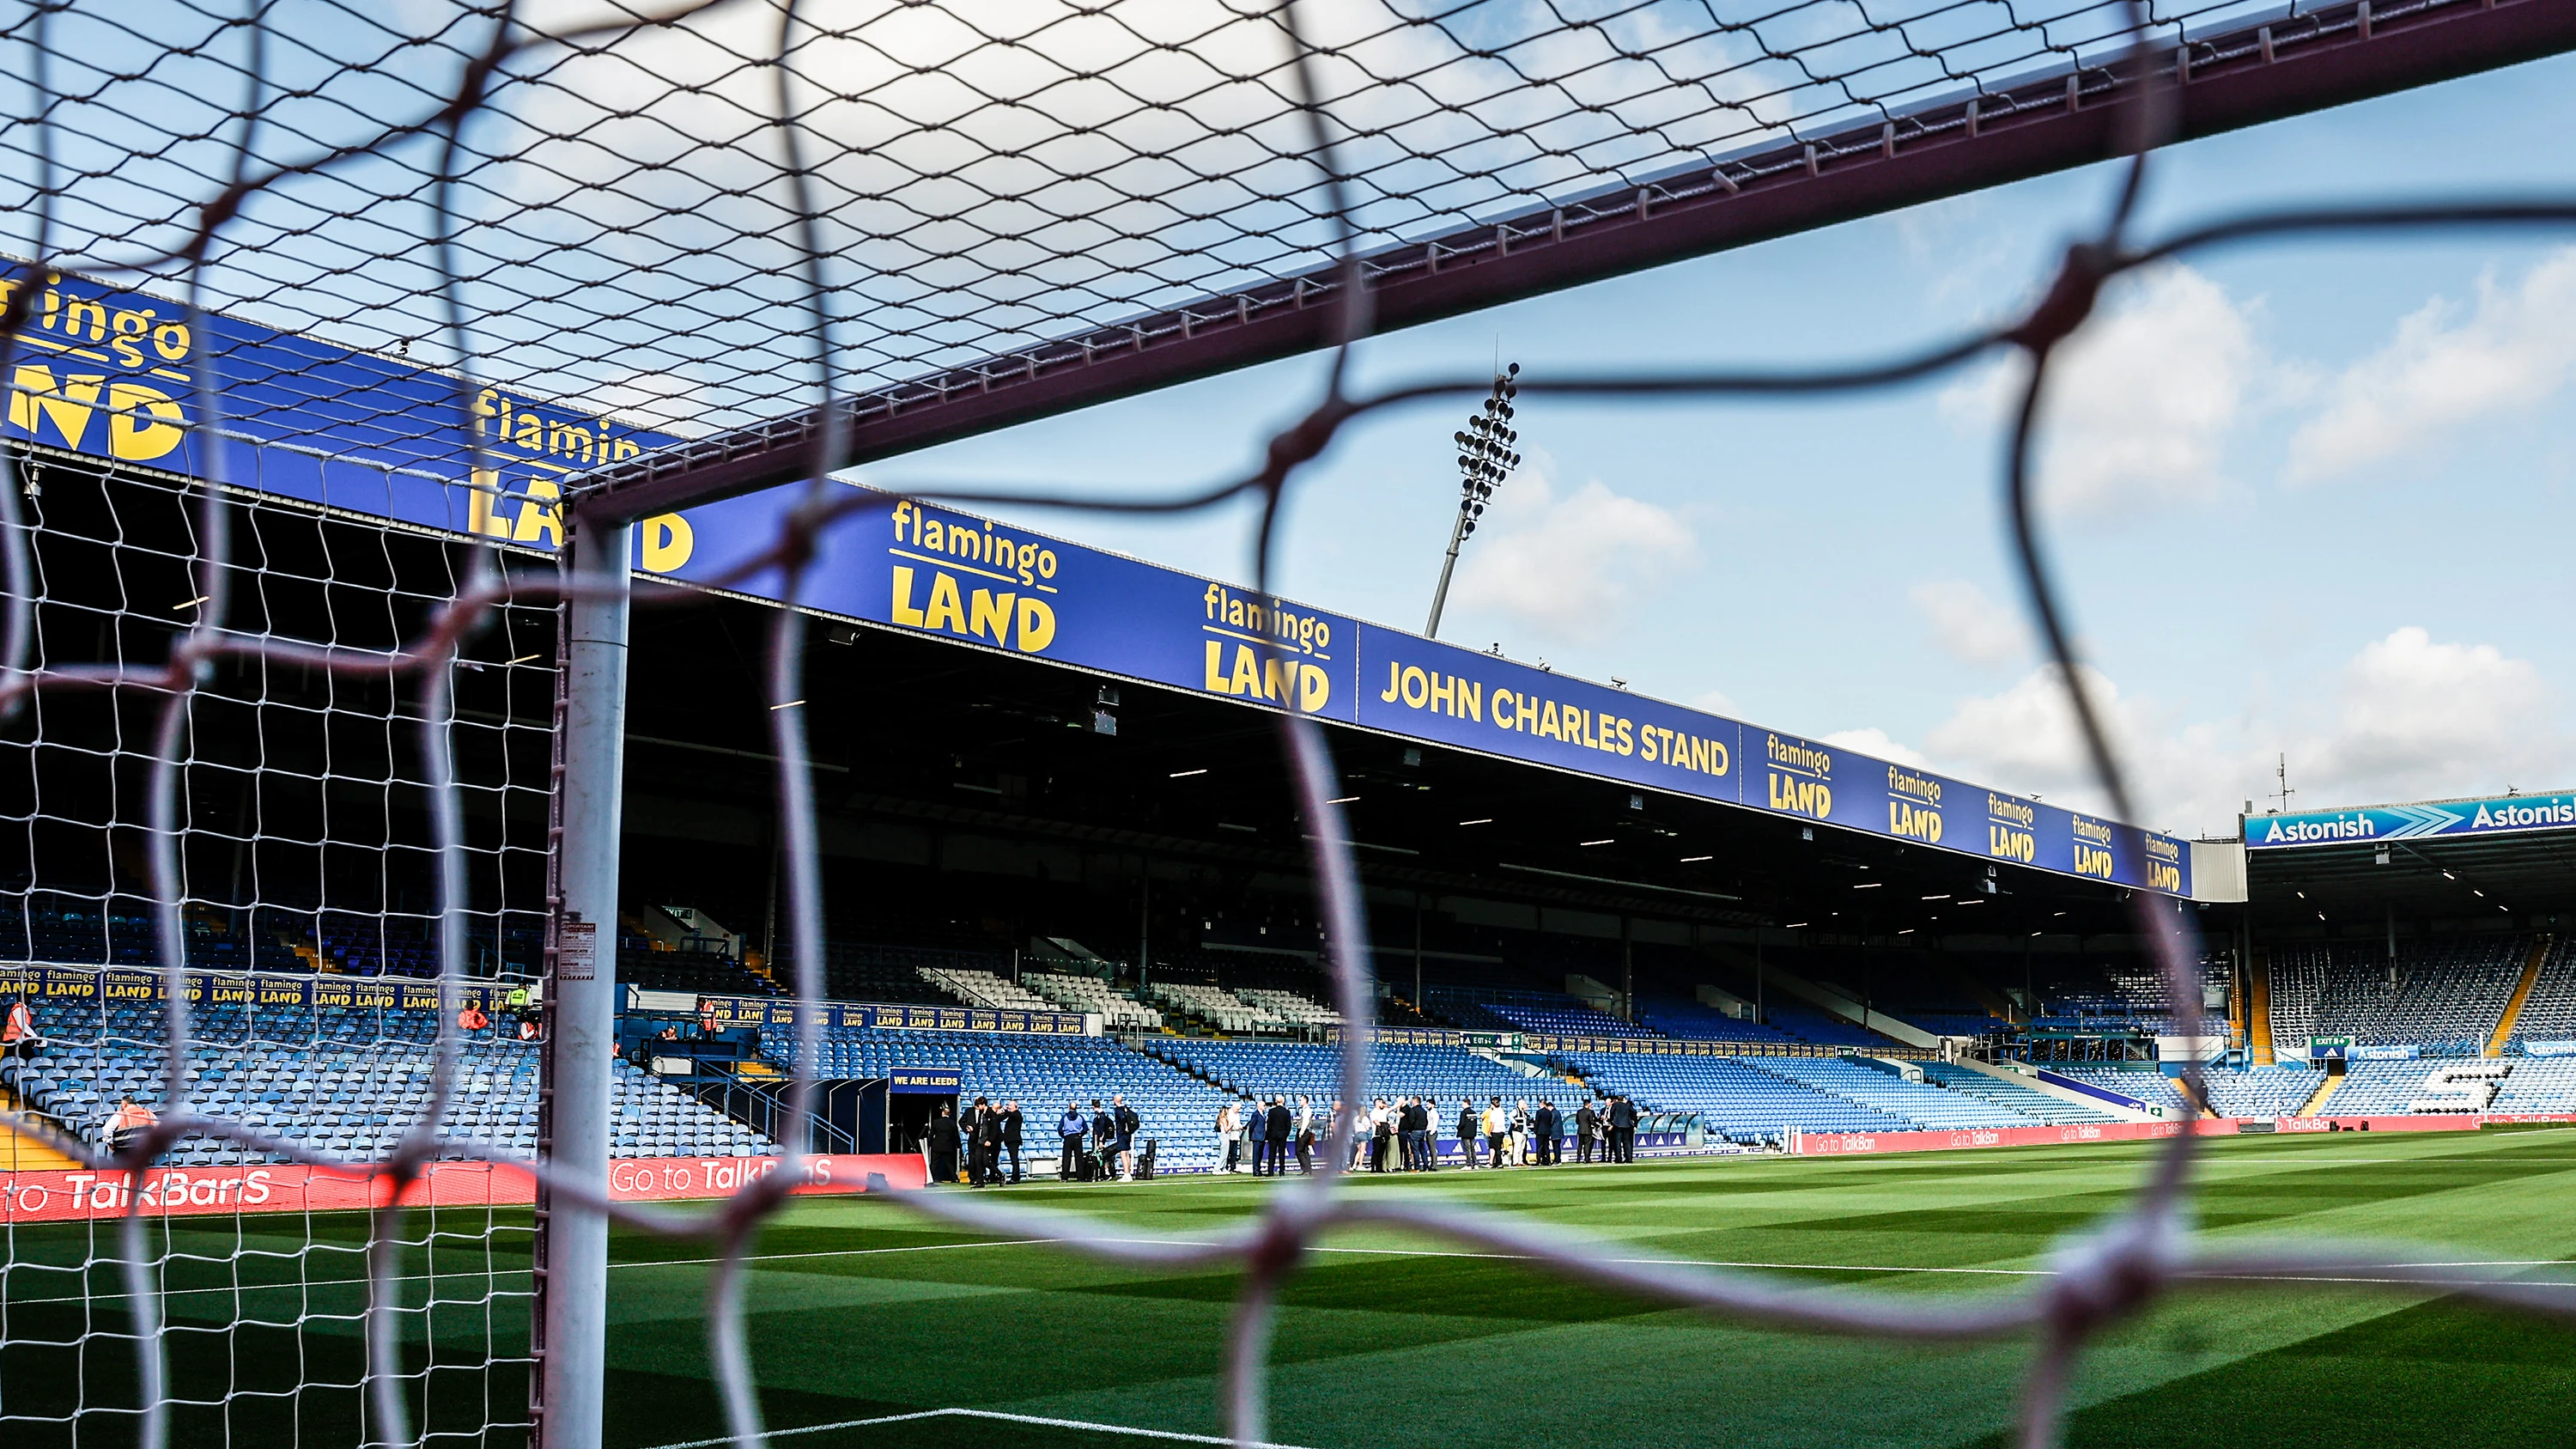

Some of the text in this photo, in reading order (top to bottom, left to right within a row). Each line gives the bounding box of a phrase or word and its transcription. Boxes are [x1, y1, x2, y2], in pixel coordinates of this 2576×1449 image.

[468, 466, 694, 574] LAD
[891, 501, 1058, 586] flamingo
[891, 564, 1056, 652] LAND
[1204, 583, 1330, 654] flamingo
[1206, 640, 1330, 713] LAND
[1381, 661, 1728, 776] JOHN CHARLES STAND
[1767, 734, 1831, 777] flamingo
[1887, 765, 1941, 807] flamingo
[1768, 772, 1832, 819] LAND
[1988, 792, 2033, 830] flamingo
[2471, 797, 2576, 829] Astonis
[1889, 801, 1942, 843] LAND
[2264, 813, 2374, 843] Astonish
[2072, 814, 2111, 845] flamingo
[1989, 825, 2035, 863] LAND
[2145, 832, 2178, 862] flamingo
[2074, 844, 2113, 879] LAND
[2147, 861, 2180, 892] LAND
[46, 970, 95, 983] flamingo
[106, 972, 152, 984] flamingo
[213, 977, 256, 988] flamino
[46, 983, 94, 996] LAND
[106, 985, 152, 998] LAND
[260, 979, 302, 991] flamingo
[356, 983, 395, 995] flamngo
[403, 985, 439, 997] flaming
[212, 989, 255, 1002] LAND
[260, 991, 301, 1004] LAND
[311, 993, 351, 1006] LAND
[738, 1000, 768, 1010] flamingo
[877, 1006, 903, 1016] flamingo
[909, 1008, 935, 1017] flamingo
[940, 1009, 965, 1019] flamingo
[971, 1011, 996, 1020] flamingo
[1000, 1012, 1025, 1021] flamingo
[1030, 1014, 1054, 1022] flamingo
[1058, 1014, 1081, 1024] flamingo
[772, 1015, 793, 1024] LAND
[877, 1016, 902, 1026] LAND
[908, 1018, 934, 1027] LAND
[939, 1019, 965, 1029] LAND
[971, 1020, 996, 1030] LAND
[1000, 1021, 1024, 1031] LAND
[1030, 1022, 1054, 1032] LAND
[1058, 1024, 1080, 1033] LAND
[2357, 1045, 2409, 1059] Astonish
[894, 1075, 958, 1086] WE ARE LEEDS
[2061, 1125, 2101, 1141] Go to TalkBan
[2151, 1123, 2159, 1136] Go
[1815, 1135, 1875, 1153] Go to TalkBan
[1951, 1131, 1999, 1147] Go to TalkBan
[612, 1159, 831, 1192] Go to TalkBnS
[2, 1178, 48, 1212] to
